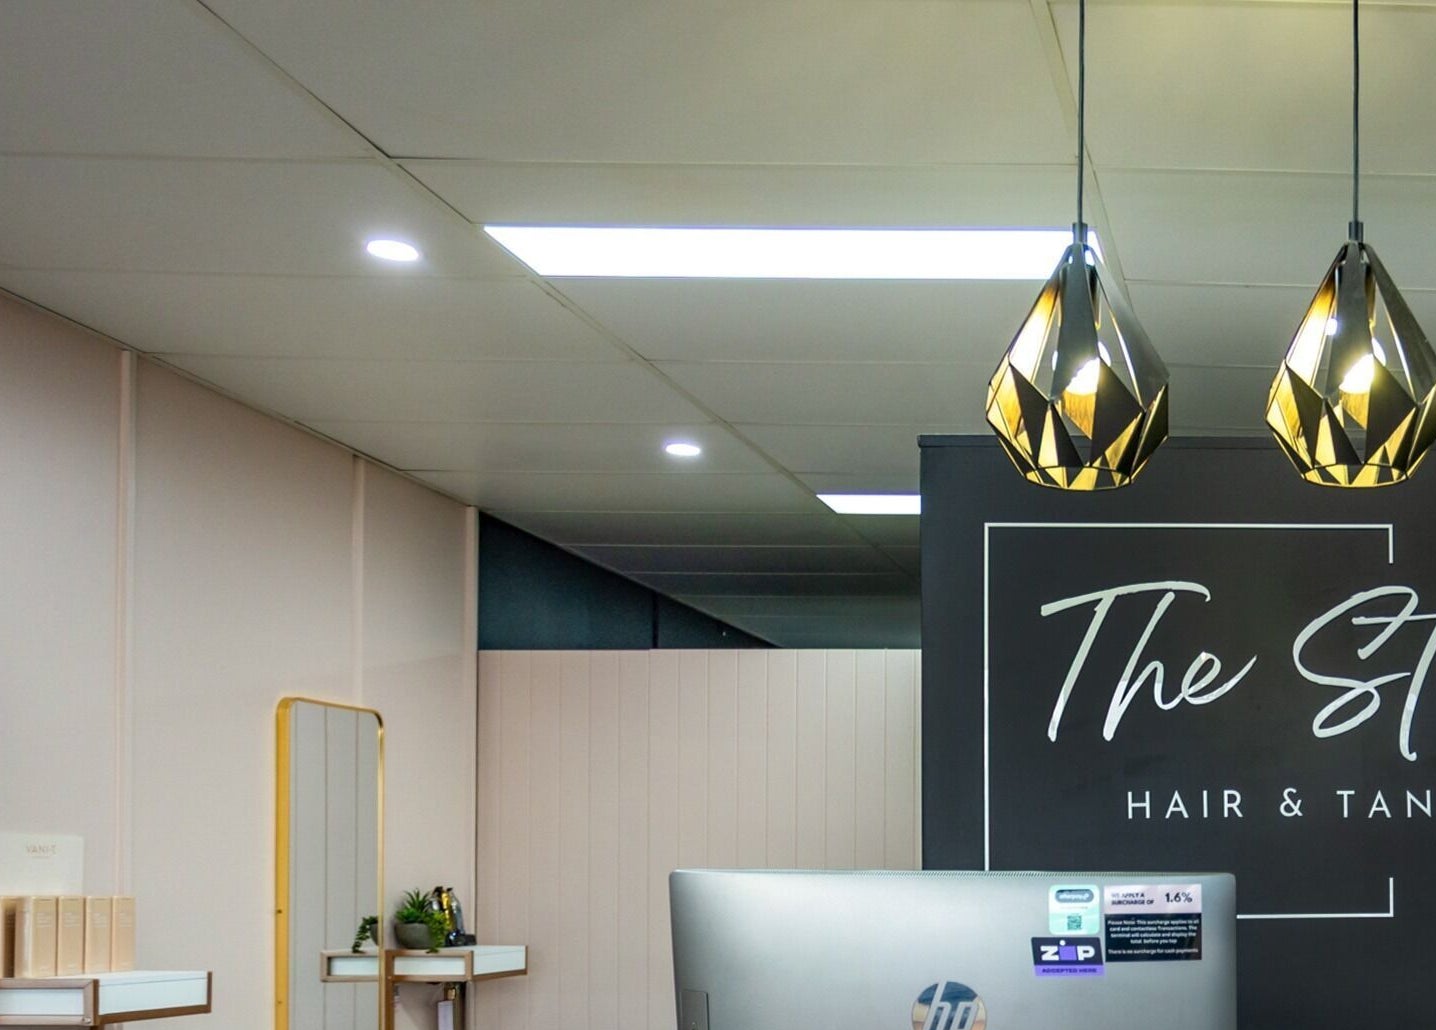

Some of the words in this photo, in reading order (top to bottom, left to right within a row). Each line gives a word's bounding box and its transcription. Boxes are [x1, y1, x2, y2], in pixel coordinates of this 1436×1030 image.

[1040, 580, 1257, 743] The
[1127, 789, 1245, 820] HAIR
[1279, 787, 1304, 818] &
[1164, 892, 1193, 903] 1.6%
